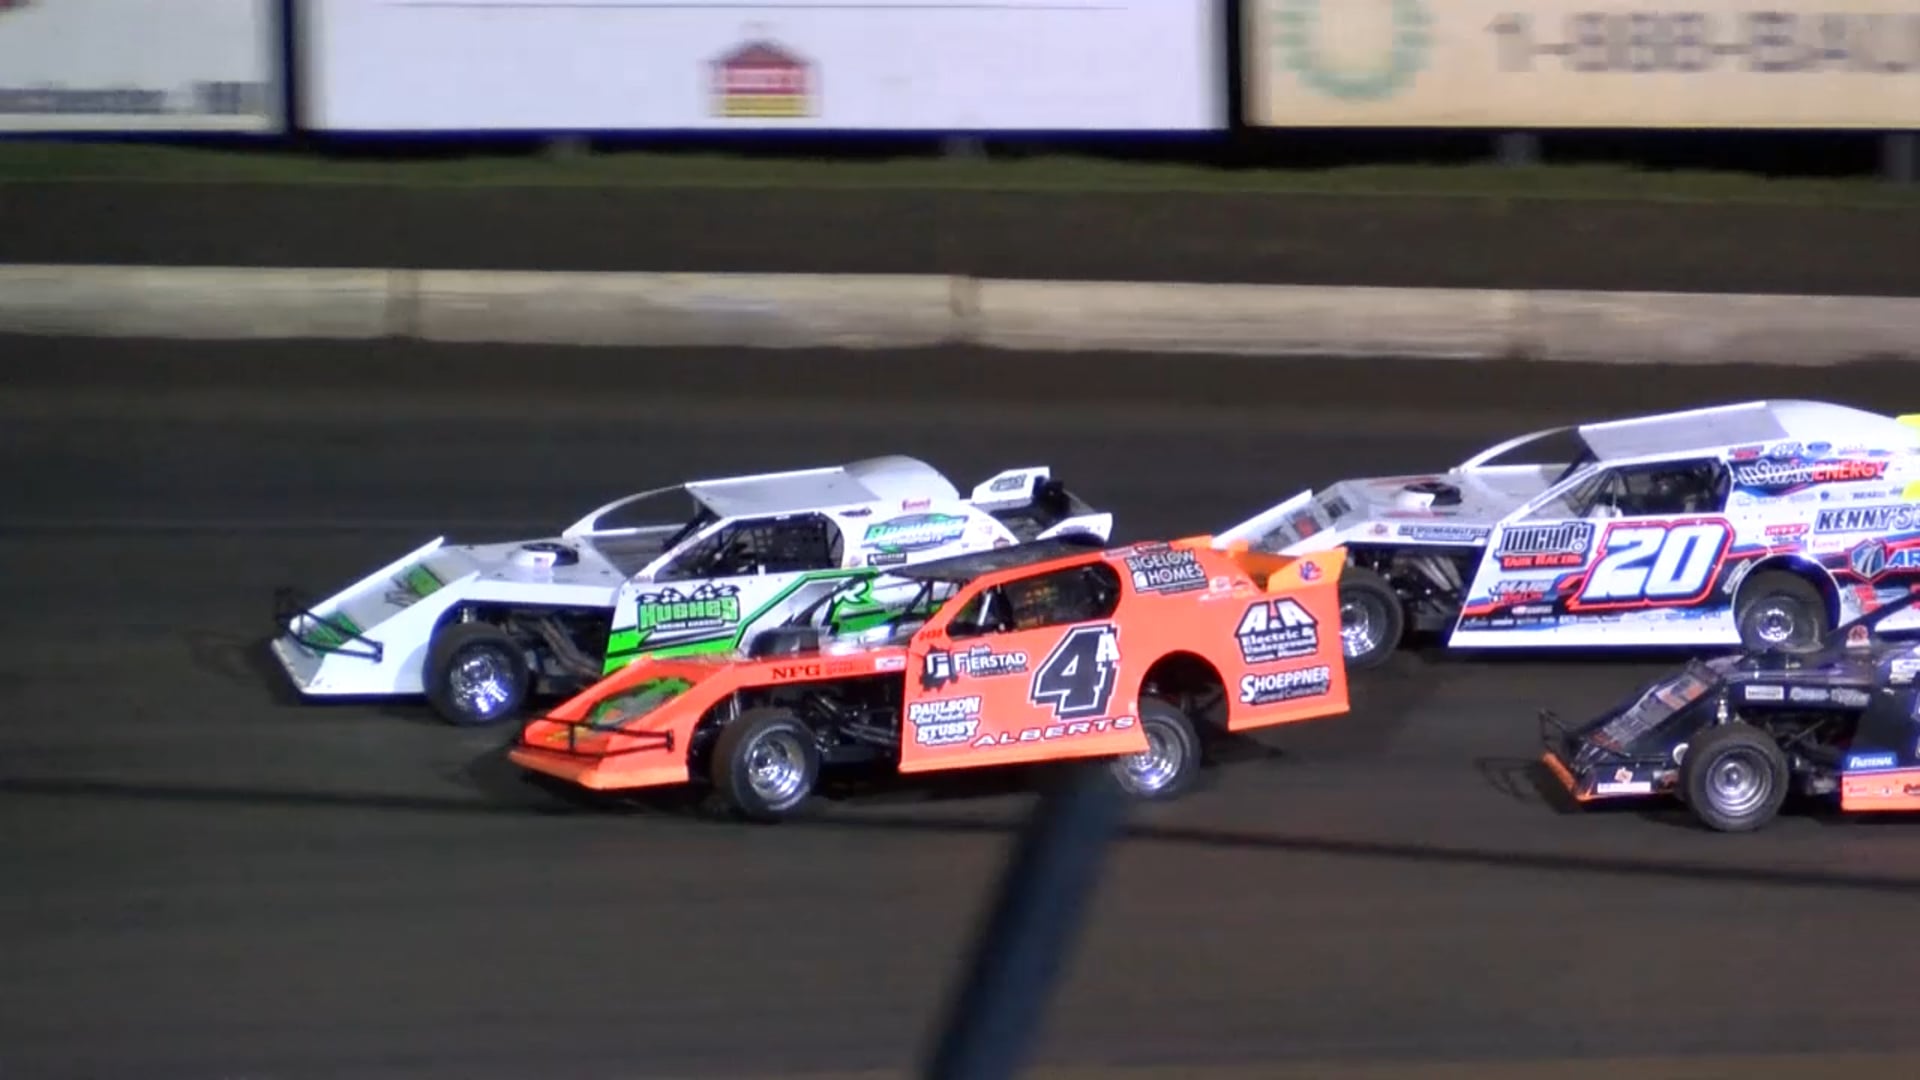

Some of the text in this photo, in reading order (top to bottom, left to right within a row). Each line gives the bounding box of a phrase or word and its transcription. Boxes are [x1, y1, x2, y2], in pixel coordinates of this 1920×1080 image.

[1126, 550, 1195, 570] BIGELOW
[1577, 521, 1731, 602] 20
[1148, 563, 1205, 584] HOMES
[1240, 666, 1330, 703] SHOEPPNER
[909, 696, 981, 721] PAULSON
[917, 719, 979, 743] STUSSY
[972, 716, 1136, 748] ALBERTS
